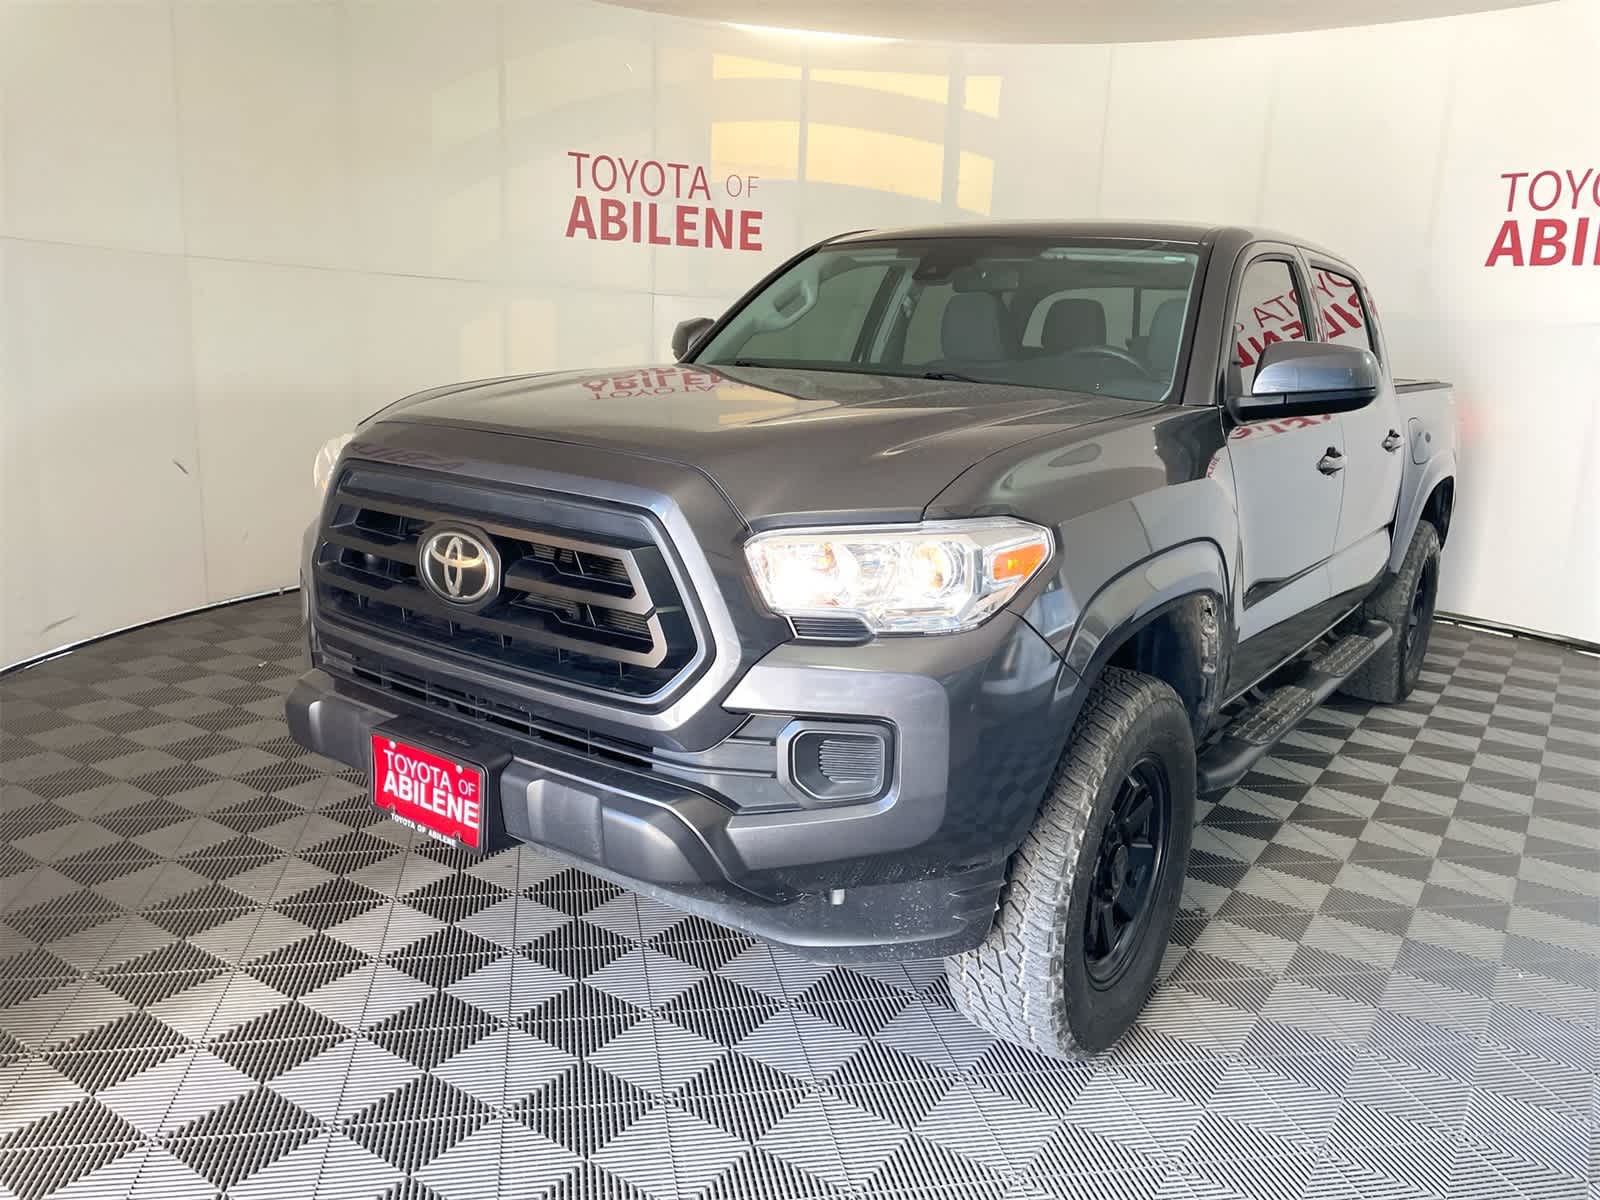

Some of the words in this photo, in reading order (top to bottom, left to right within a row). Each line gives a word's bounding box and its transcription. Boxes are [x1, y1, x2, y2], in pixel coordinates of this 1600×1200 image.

[567, 151, 711, 200] TOYOTA
[726, 174, 760, 198] OF
[1501, 168, 1600, 212] TOY
[565, 195, 763, 251] ABILENE
[1484, 217, 1600, 266] ABI
[383, 749, 452, 793] TOYOTA
[458, 779, 477, 797] OF
[383, 770, 479, 829] ABILENE
[390, 812, 416, 830] TOYOTA
[416, 824, 427, 833] OF
[428, 828, 458, 848] ABILENE
